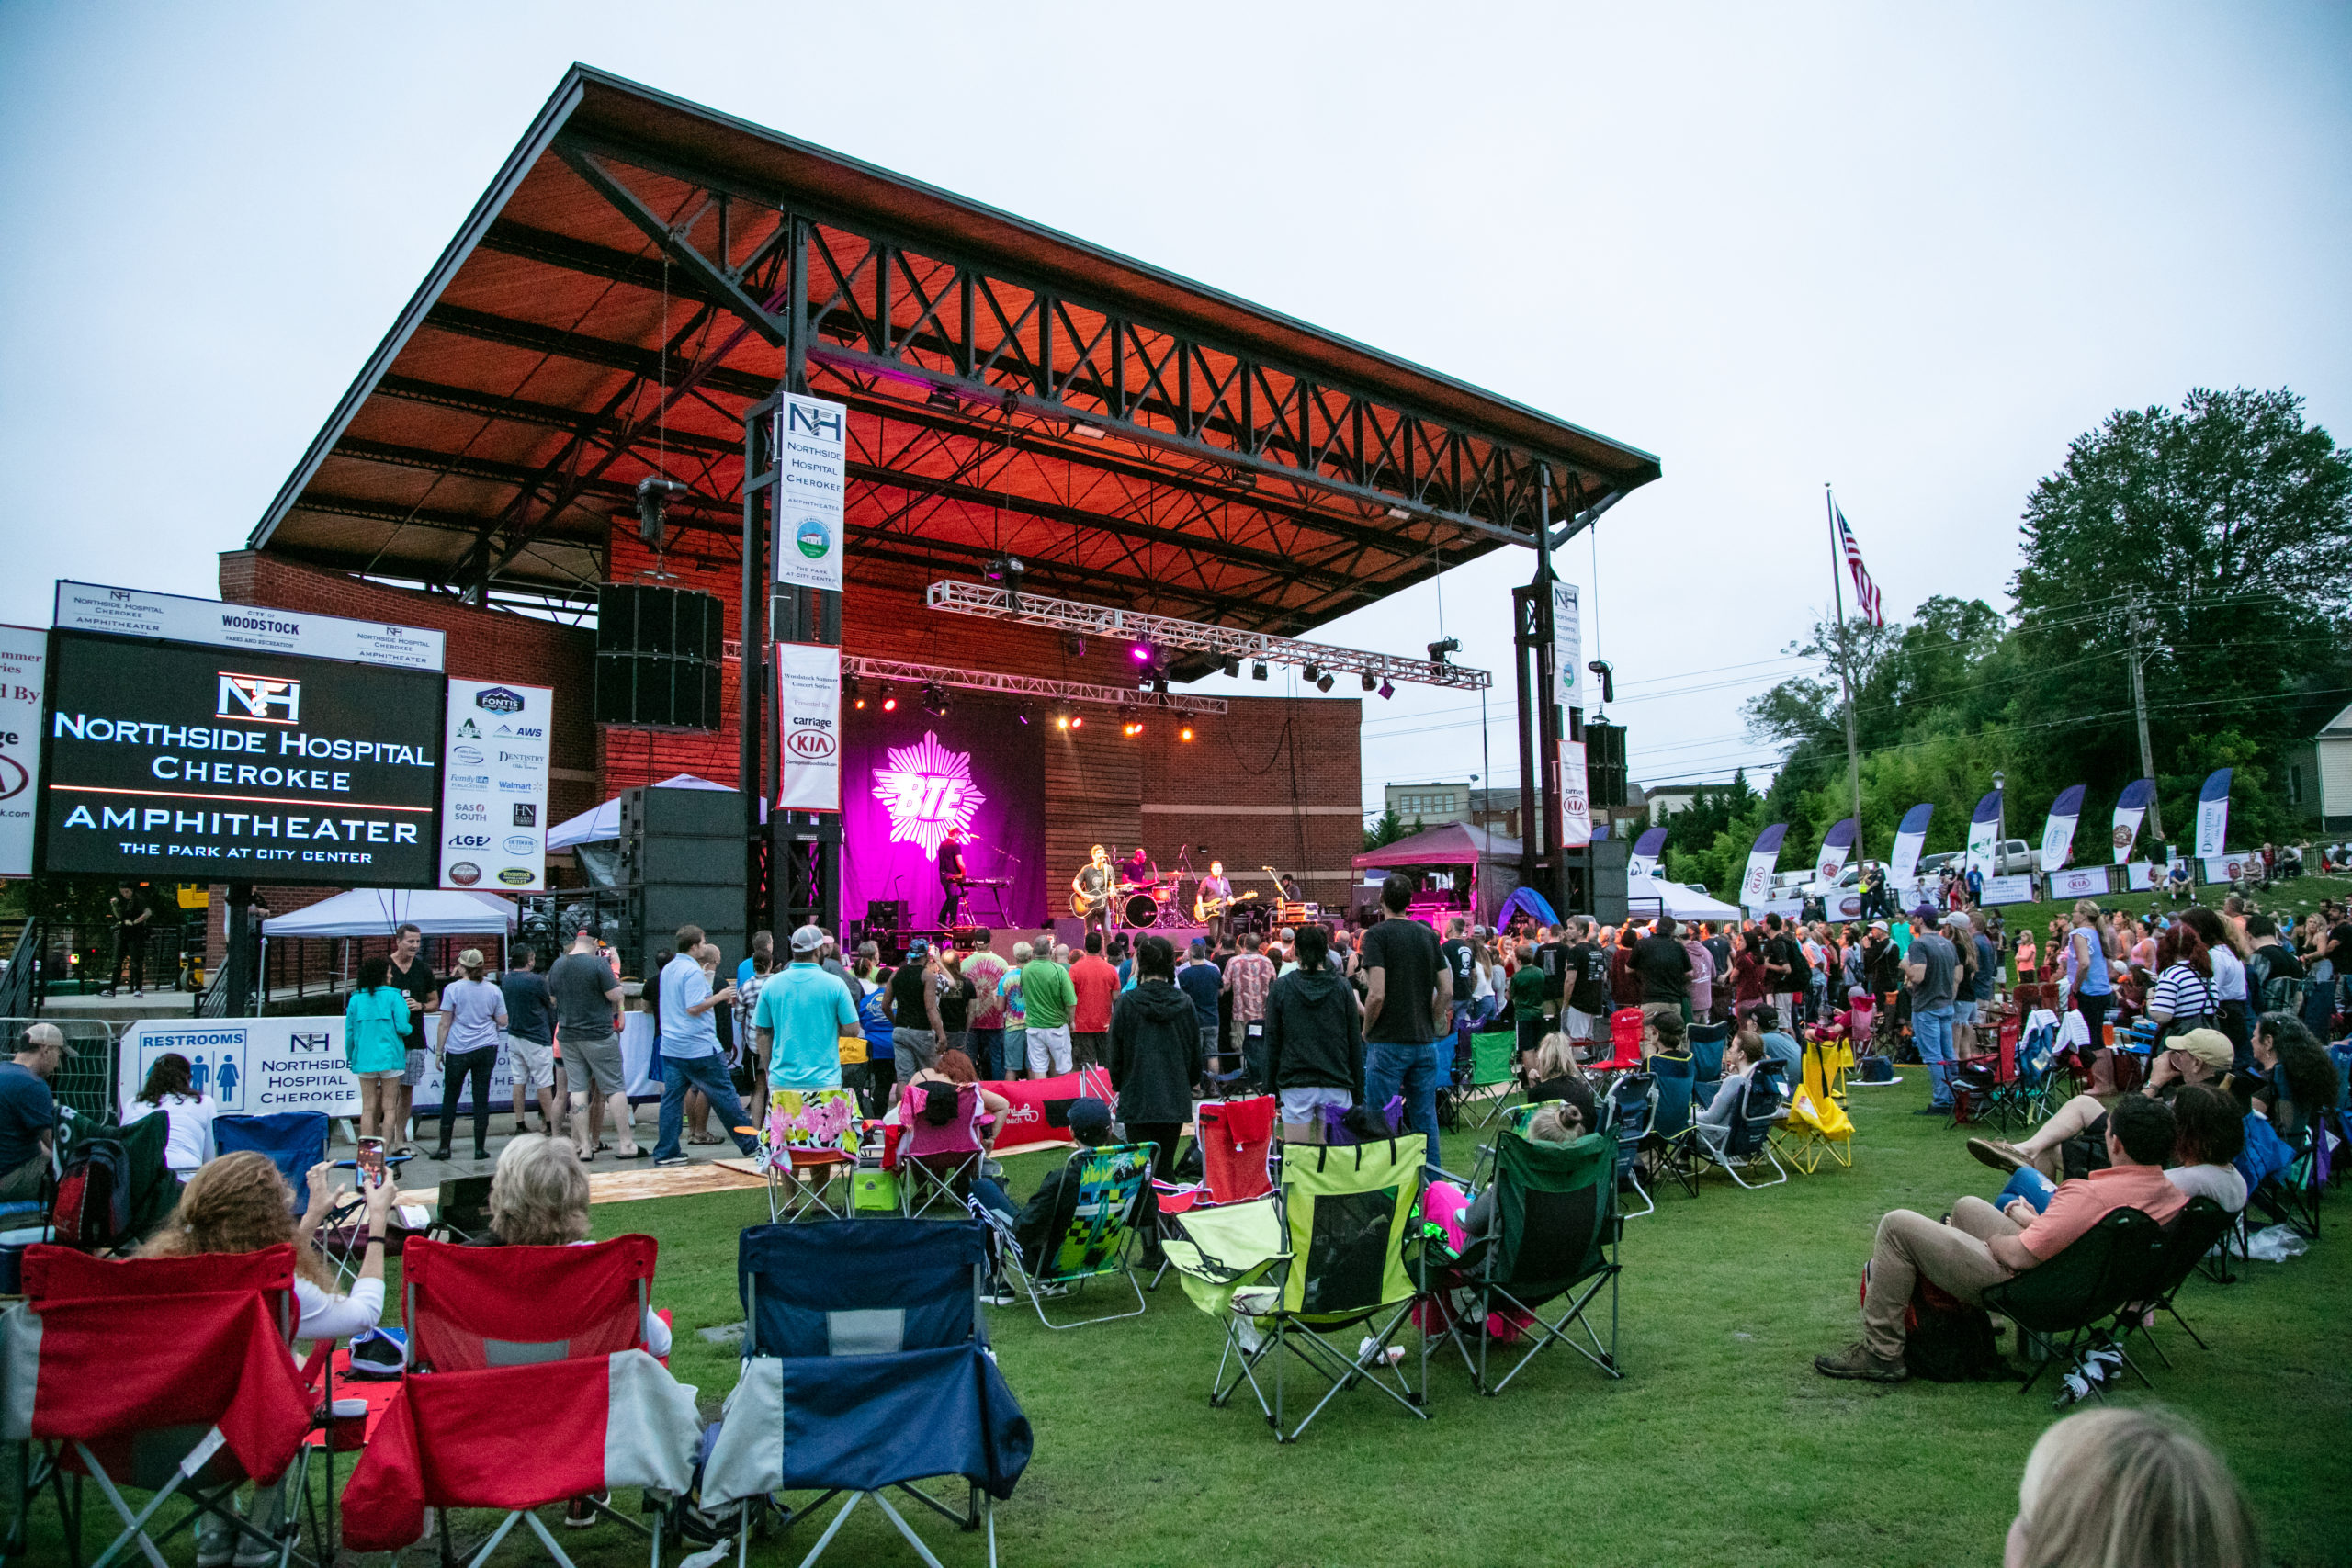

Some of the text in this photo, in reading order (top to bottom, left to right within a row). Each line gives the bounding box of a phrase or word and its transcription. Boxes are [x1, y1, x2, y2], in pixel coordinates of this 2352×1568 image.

[789, 402, 842, 442] NH
[787, 441, 842, 461] NORTHSIDE
[792, 458, 838, 476] HOSPITAL
[786, 474, 841, 492] CHEROKEE
[74, 597, 164, 614] NORTHSIDE HOSPITAL
[95, 607, 142, 618] CHEROKEE
[76, 617, 160, 631] AMPHITHEATER
[222, 615, 300, 635] WOODSTOCK
[357, 633, 430, 648] NORTHSIDE HOSPITAL
[374, 642, 413, 651] CHEROKEE
[359, 650, 427, 663] AMPHITHEATER
[784, 673, 839, 683] Woodstock Summer
[792, 681, 814, 689] Concert
[14, 686, 41, 705] By
[217, 676, 300, 721] NH
[482, 698, 518, 707] FONTIS
[793, 716, 832, 729] carriage
[53, 711, 266, 754] NORTHSIDE
[279, 731, 435, 767] HOSPITAL
[516, 728, 543, 738] AWS
[797, 735, 829, 752] KIA
[499, 750, 545, 762] DENTISTRY
[153, 756, 351, 792] CHEROKEE
[450, 773, 476, 784] Family
[499, 781, 532, 790] Walmart
[874, 769, 970, 819] BTE
[455, 804, 475, 812] GAS
[515, 804, 535, 817] HN
[1568, 800, 1585, 811] KIA
[455, 813, 487, 822] SOUTH
[63, 805, 418, 844] AMPHITHEATER
[456, 835, 484, 846] LGE
[120, 842, 372, 863] THE PARK AT CITY CENTER
[1752, 872, 1764, 889] KIA
[142, 1034, 243, 1047] RESTROOMS
[290, 1033, 330, 1053] NH
[269, 1076, 348, 1089] HOSPITAL
[260, 1090, 356, 1104] CHEROKEE
[1008, 1104, 1016, 1114] nd
[1006, 1113, 1023, 1124] ouch
